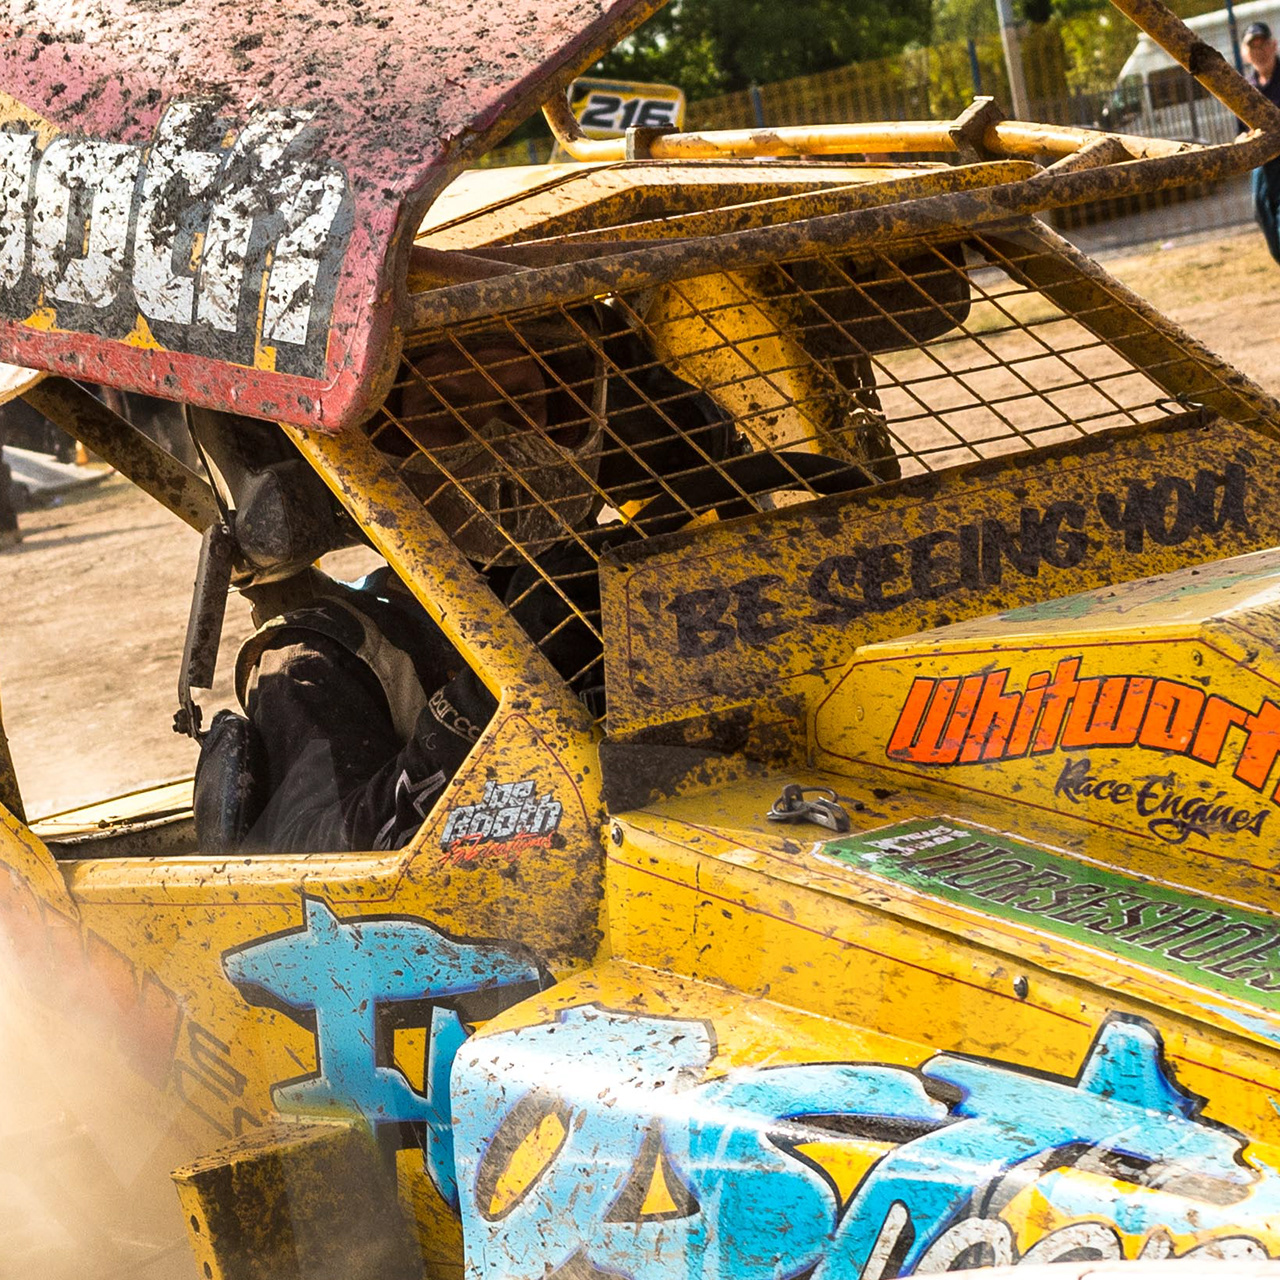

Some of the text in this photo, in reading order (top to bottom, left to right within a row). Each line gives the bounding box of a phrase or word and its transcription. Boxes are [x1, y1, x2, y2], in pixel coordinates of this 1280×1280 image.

[580, 95, 677, 129] 216
[806, 499, 1089, 625] SEEING
[1053, 757, 1270, 845] Race Engines
